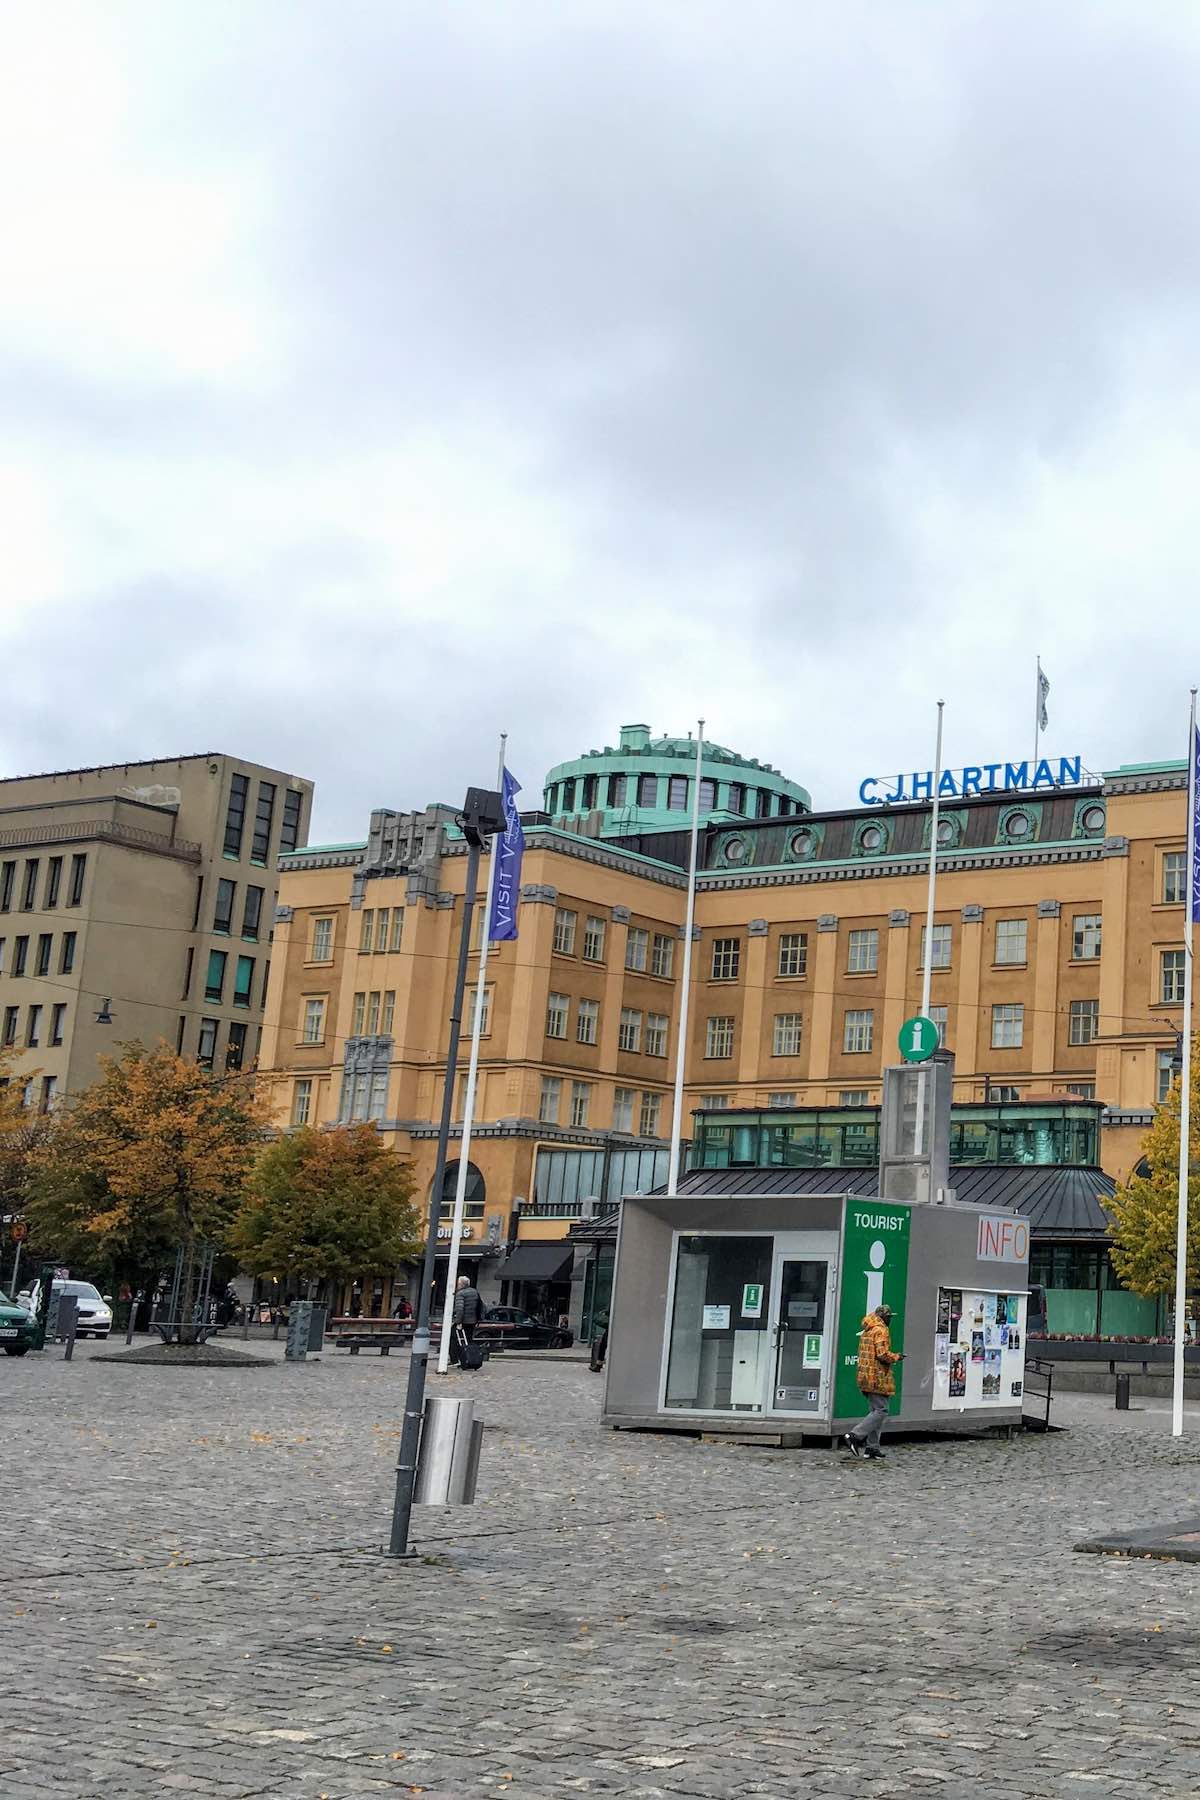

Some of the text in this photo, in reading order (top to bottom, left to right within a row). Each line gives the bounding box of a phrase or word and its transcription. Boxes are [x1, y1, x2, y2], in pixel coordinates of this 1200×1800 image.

[496, 873, 512, 927] VISIT
[854, 1213, 904, 1231] TOURIST
[978, 1219, 1028, 1259] INFO
